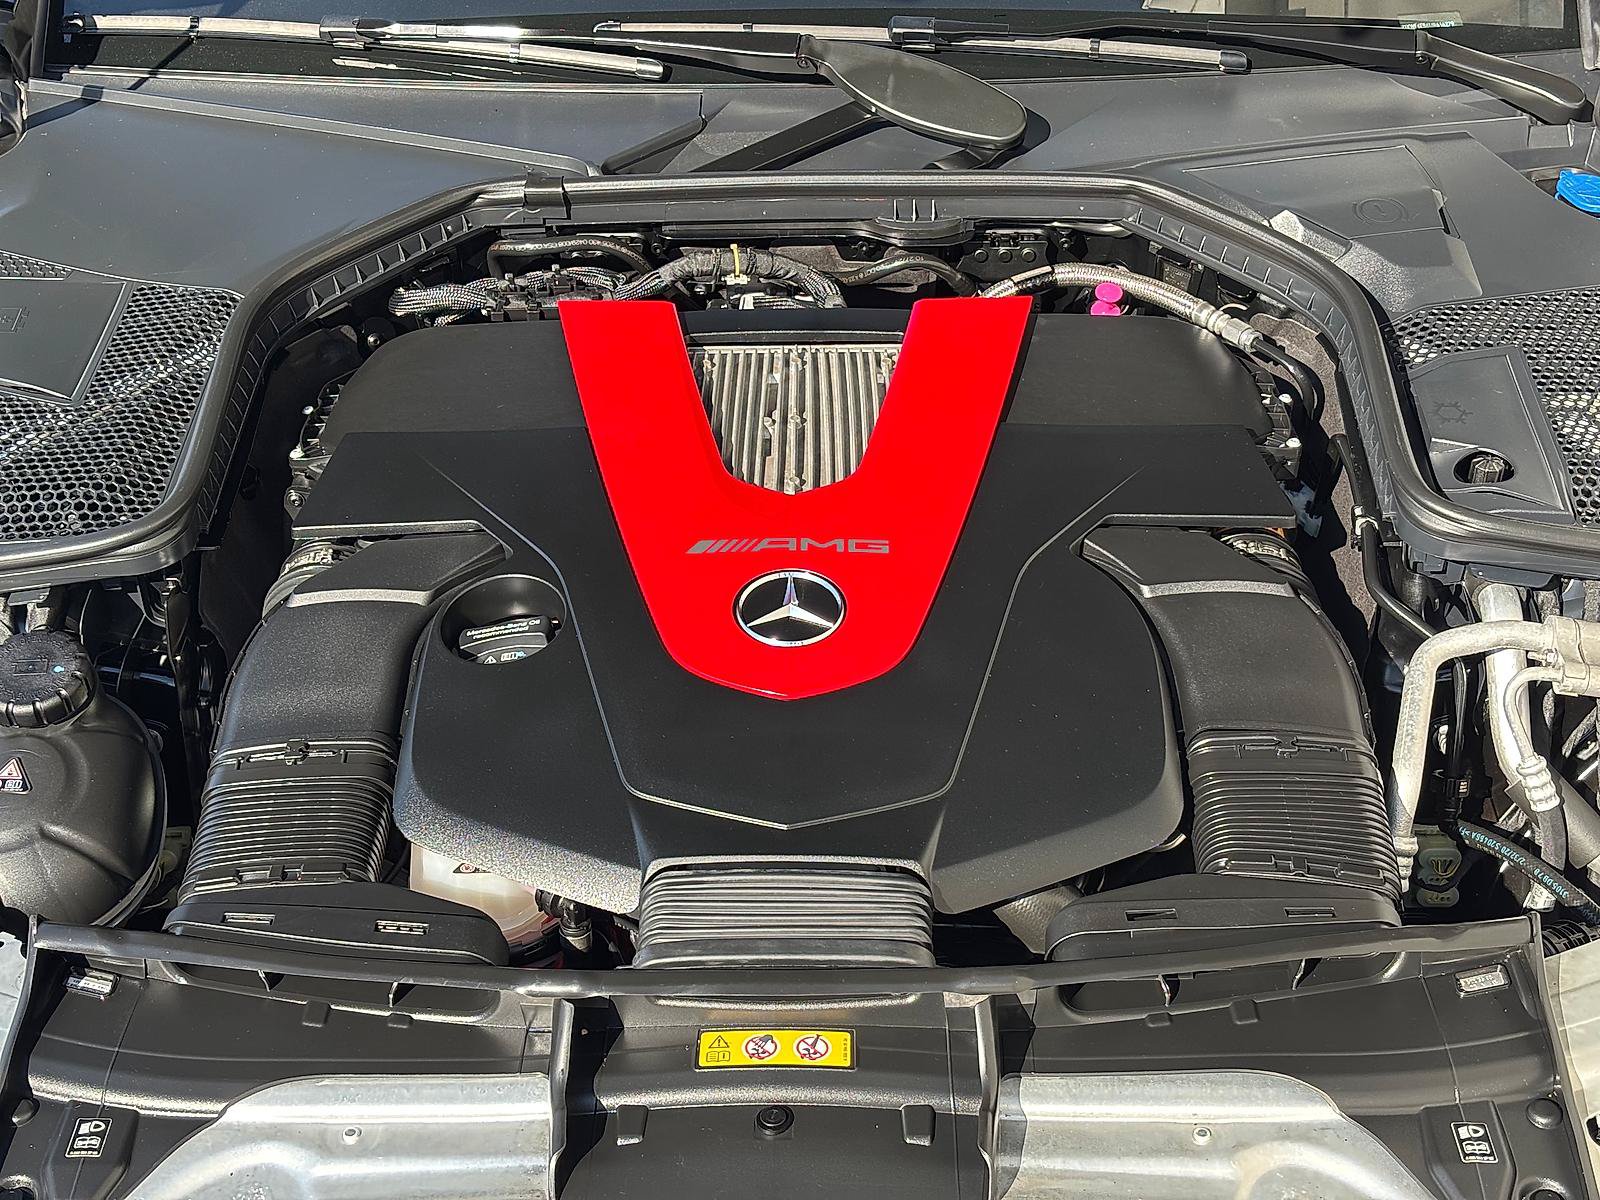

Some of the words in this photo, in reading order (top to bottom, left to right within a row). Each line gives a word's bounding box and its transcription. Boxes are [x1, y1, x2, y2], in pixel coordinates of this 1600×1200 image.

[751, 537, 889, 554] AMG
[466, 621, 528, 637] Mercedes-Benz
[472, 625, 529, 640] recommended
